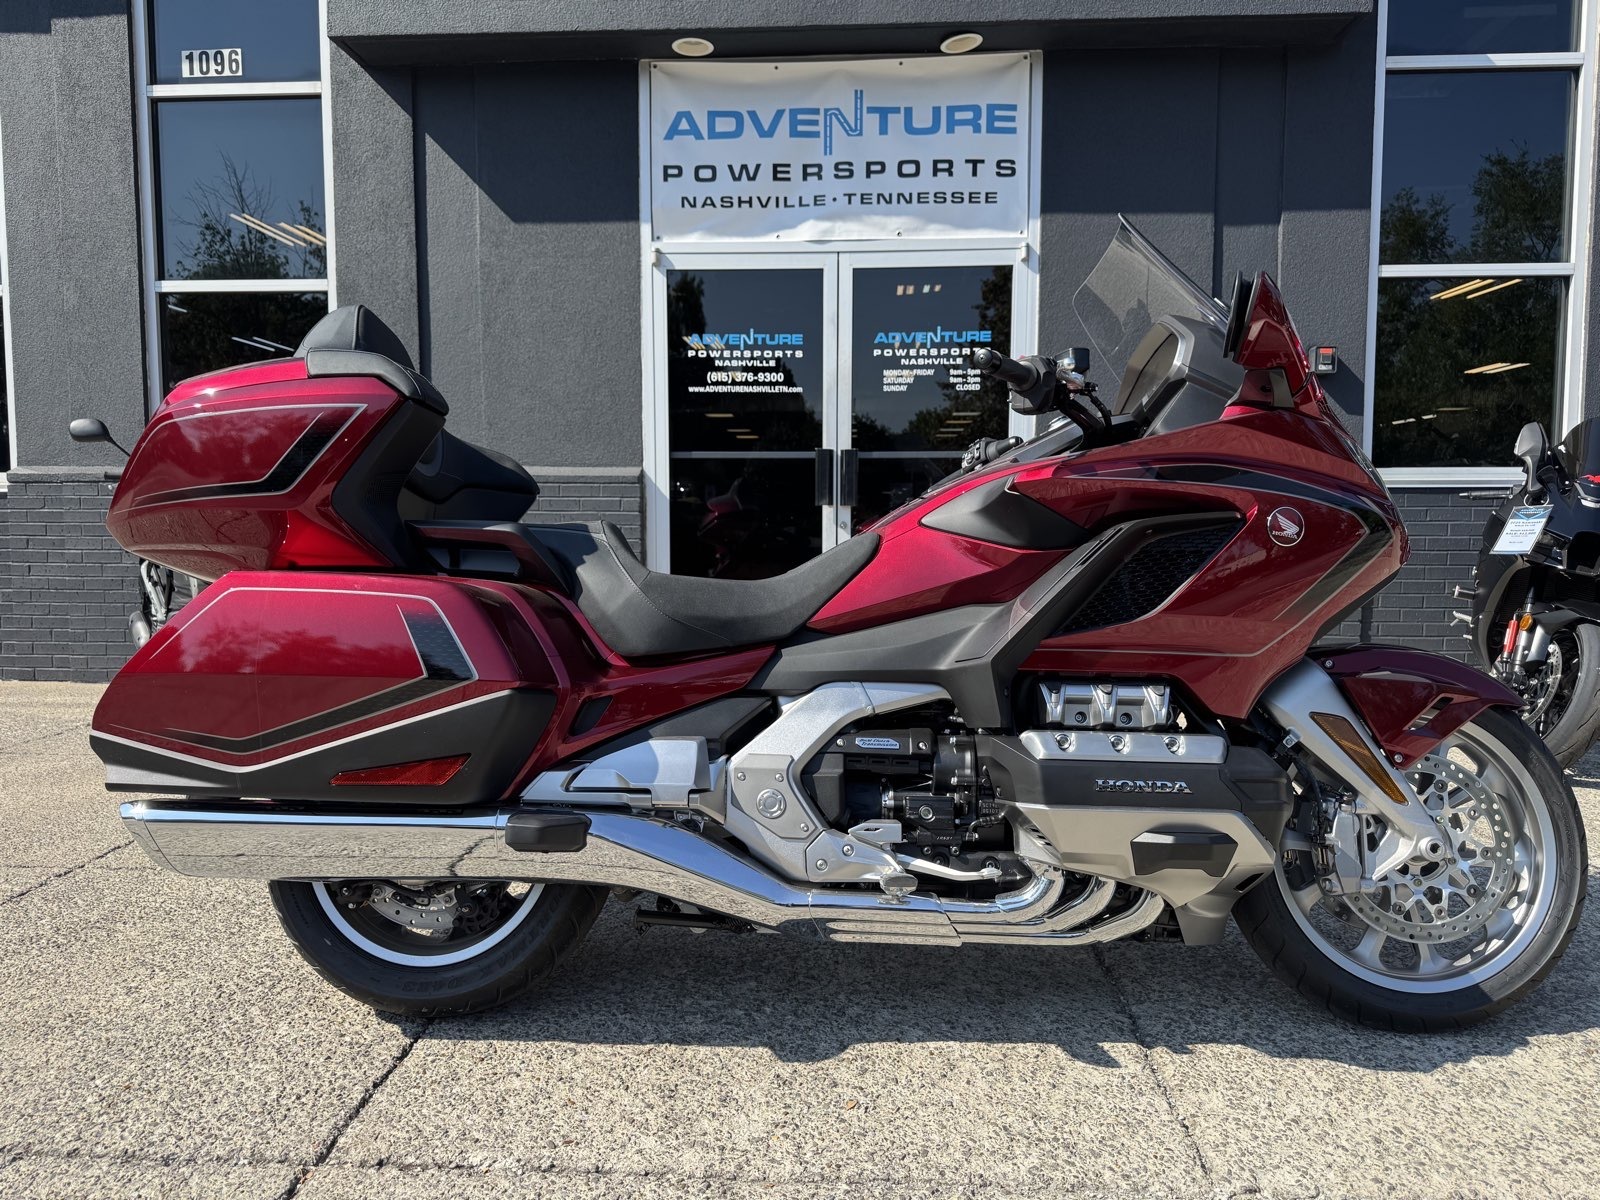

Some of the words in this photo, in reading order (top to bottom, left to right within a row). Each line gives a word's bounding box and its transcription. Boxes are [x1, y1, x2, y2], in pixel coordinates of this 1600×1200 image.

[185, 50, 240, 76] 1096
[663, 89, 1018, 156] ADVENTURE
[662, 159, 1017, 183] POWERSPORTS
[681, 194, 826, 209] NASHVILLE
[843, 191, 999, 205] TENNESSEE
[689, 328, 804, 351] ADVENTURE
[874, 326, 992, 349] ADVENTURE
[873, 347, 992, 357] POWERSPORT
[706, 371, 733, 384] (615)
[735, 371, 785, 383] 376-9300
[883, 376, 915, 384] SATURDAY
[688, 385, 803, 393] www.ADVENTURENASHVILLETN.com
[1272, 530, 1298, 539] HONDA
[1095, 779, 1193, 795] HONDA
